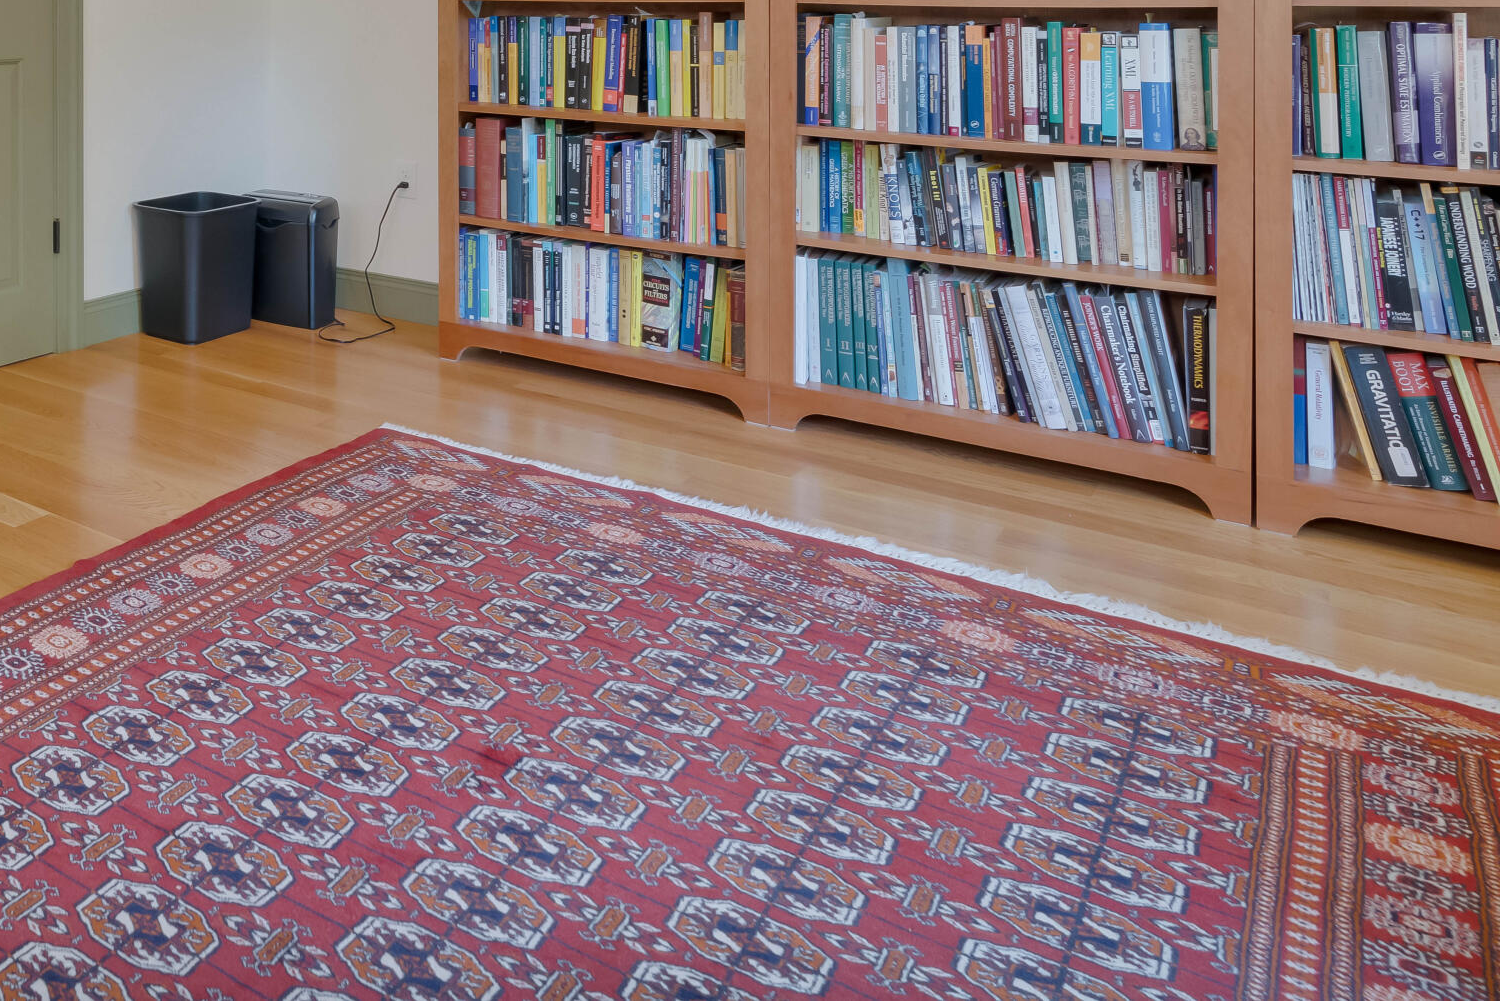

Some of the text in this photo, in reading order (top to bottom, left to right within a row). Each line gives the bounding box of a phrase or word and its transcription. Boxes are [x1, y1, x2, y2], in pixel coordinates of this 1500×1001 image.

[1103, 50, 1115, 111] Learning XML
[1125, 59, 1136, 79] XML
[1396, 44, 1411, 143] OPTIMAL STATE ESTIMATION
[1432, 72, 1442, 144] Applied Combinatorics
[889, 176, 901, 217] KNOTS
[930, 170, 938, 189] knot
[1380, 217, 1401, 277] JAPANESE JOINERY
[1449, 202, 1477, 288] UNDERSTANDING WOOD
[644, 281, 669, 291] CIRCUITS
[644, 290, 668, 299] FILTERS
[1101, 305, 1135, 404] Chairmaker's Notebook
[1117, 305, 1148, 391] Chairmaking Simplified
[1193, 315, 1203, 388] THERMODYNAMICS
[1392, 361, 1414, 394] BOOT
[1410, 363, 1429, 390] MAX
[1314, 394, 1322, 420] Relativity
[1365, 370, 1403, 449] GRAVITATIO
[1426, 401, 1457, 473] INVISIBLE ARMIES
[1440, 381, 1475, 458] ILLUSTRATED CABINETMAKING
